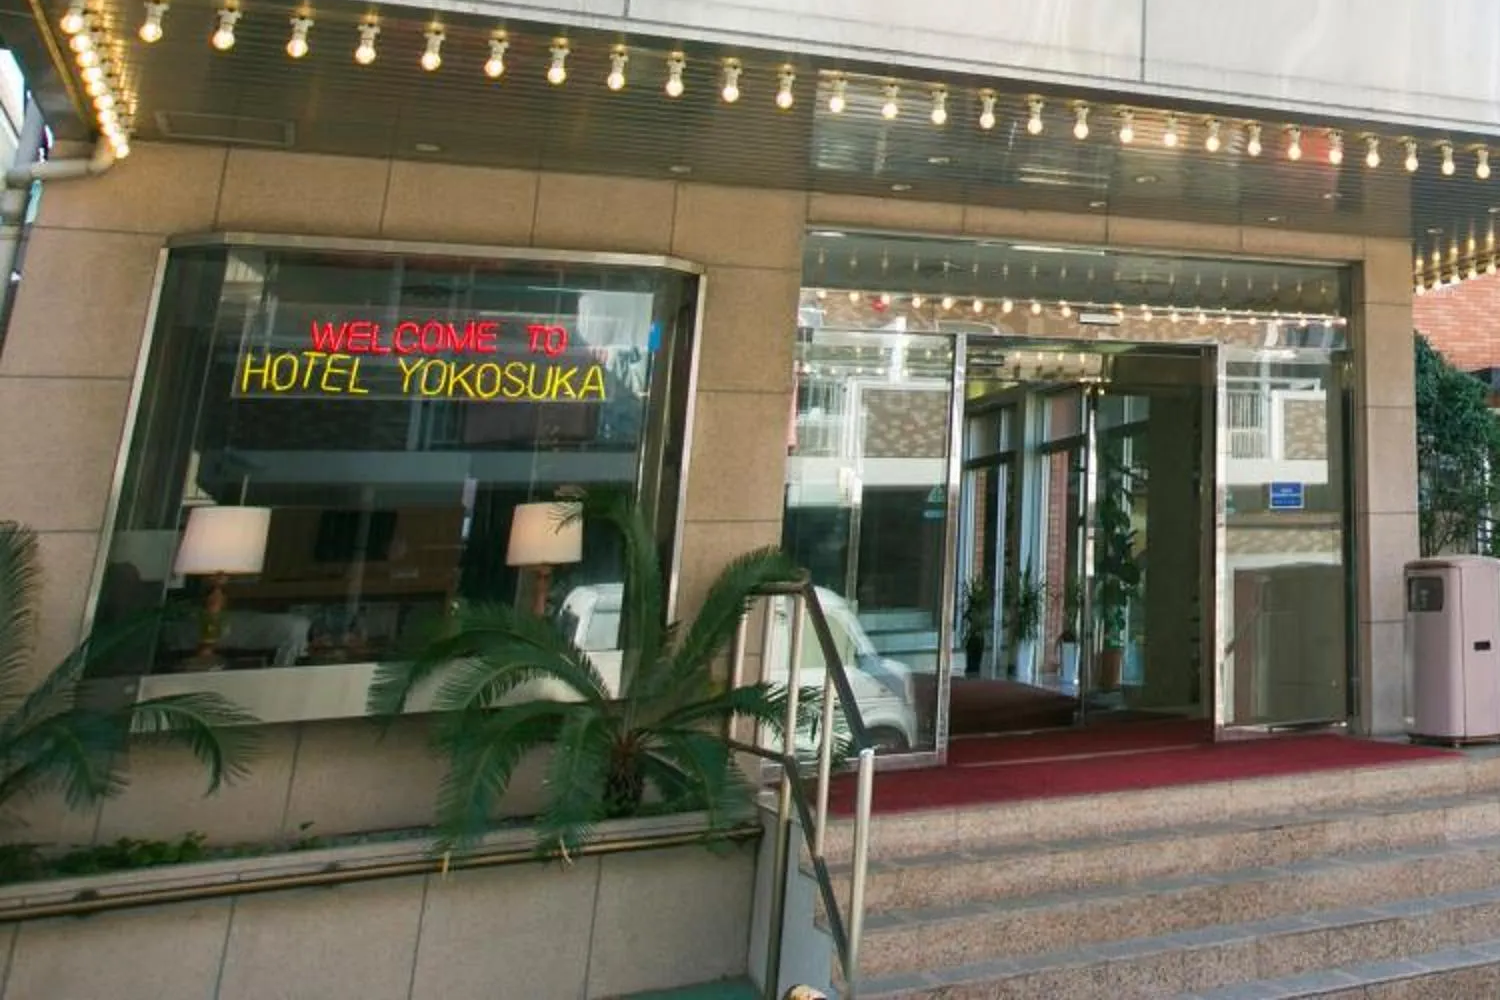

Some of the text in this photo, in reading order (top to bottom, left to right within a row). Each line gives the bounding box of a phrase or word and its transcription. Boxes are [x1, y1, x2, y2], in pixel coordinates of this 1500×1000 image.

[310, 320, 568, 357] WELCOME TO
[241, 351, 606, 399] HOTEL YOKOSUKA
